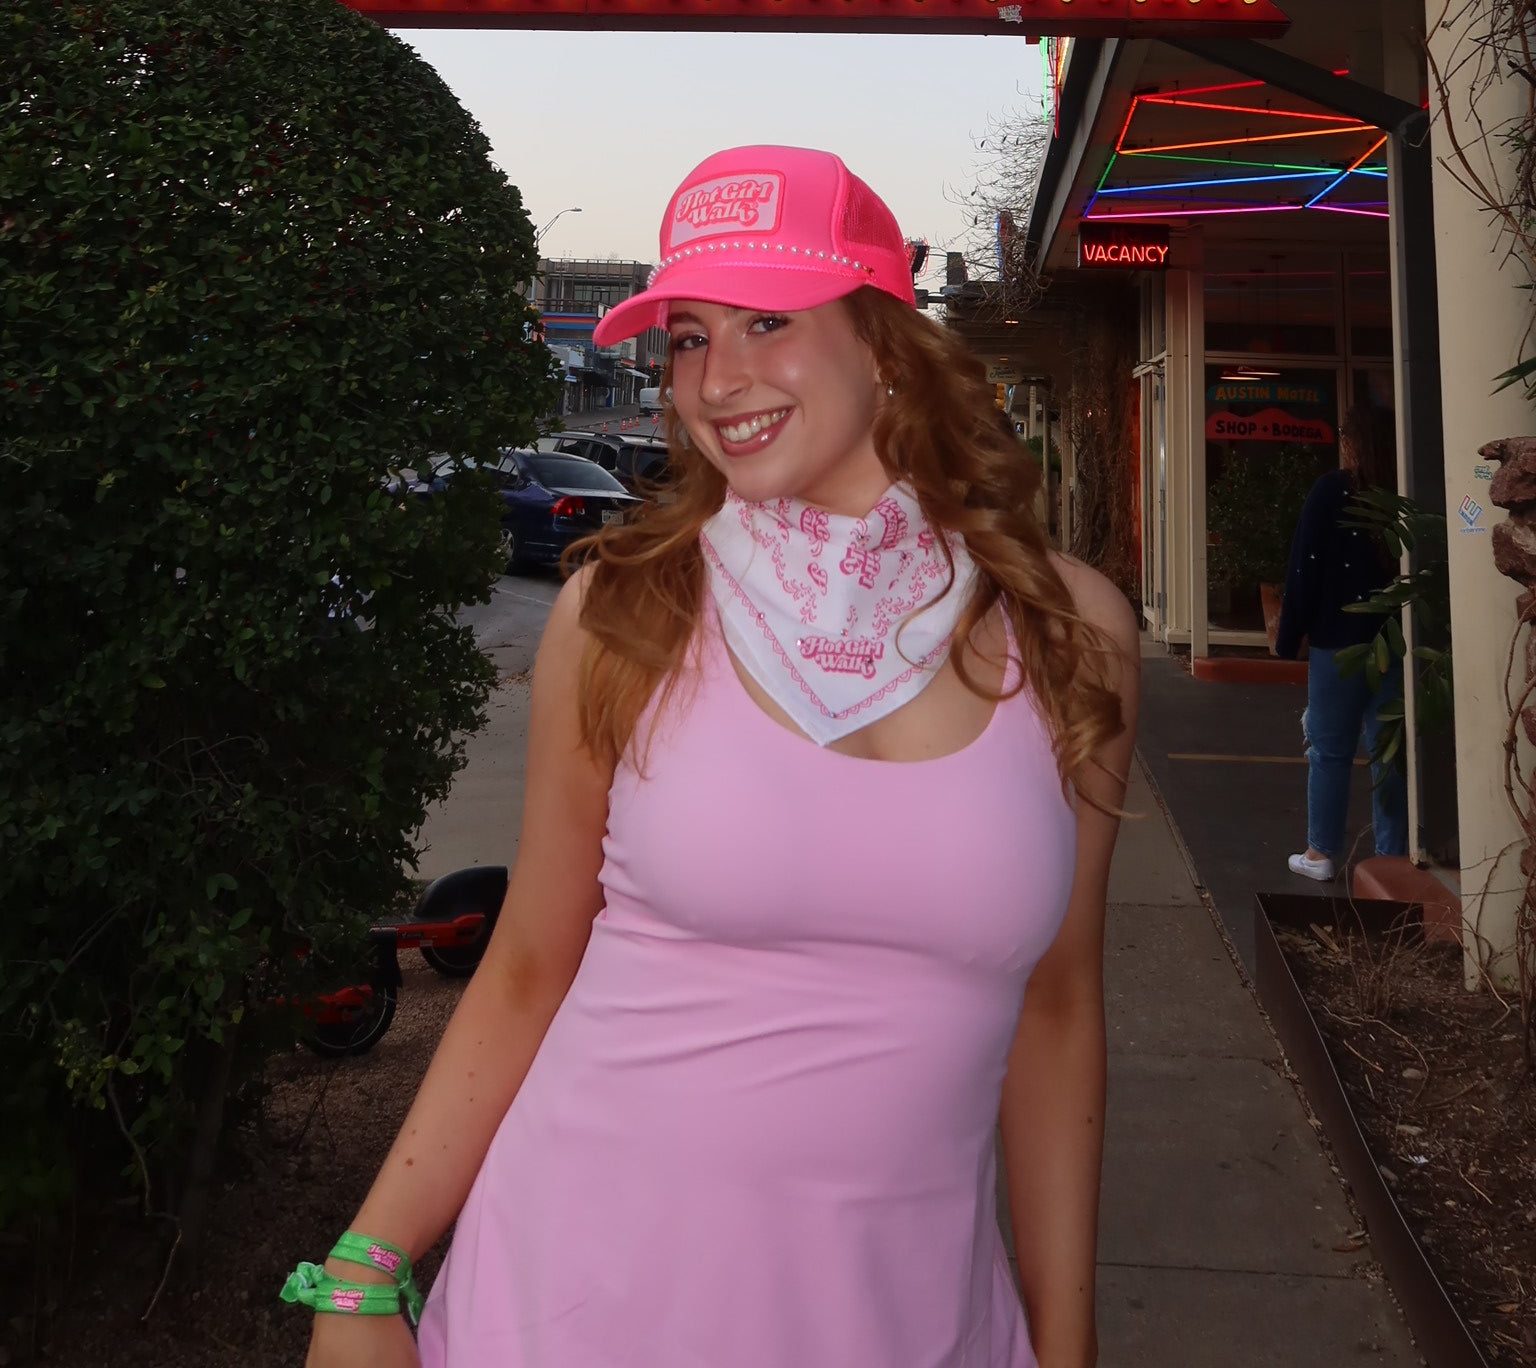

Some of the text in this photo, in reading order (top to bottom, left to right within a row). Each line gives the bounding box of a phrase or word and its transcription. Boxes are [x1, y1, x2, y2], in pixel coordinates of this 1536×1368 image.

[676, 180, 774, 222] Hot Girl
[687, 199, 759, 228] Walk
[1084, 243, 1169, 263] VACANCY
[1215, 386, 1270, 401] AUSTIN
[1215, 420, 1258, 436] SHOP
[1272, 422, 1324, 440] BODEGA
[801, 636, 884, 659] Hot Girl
[814, 654, 876, 679] Walk
